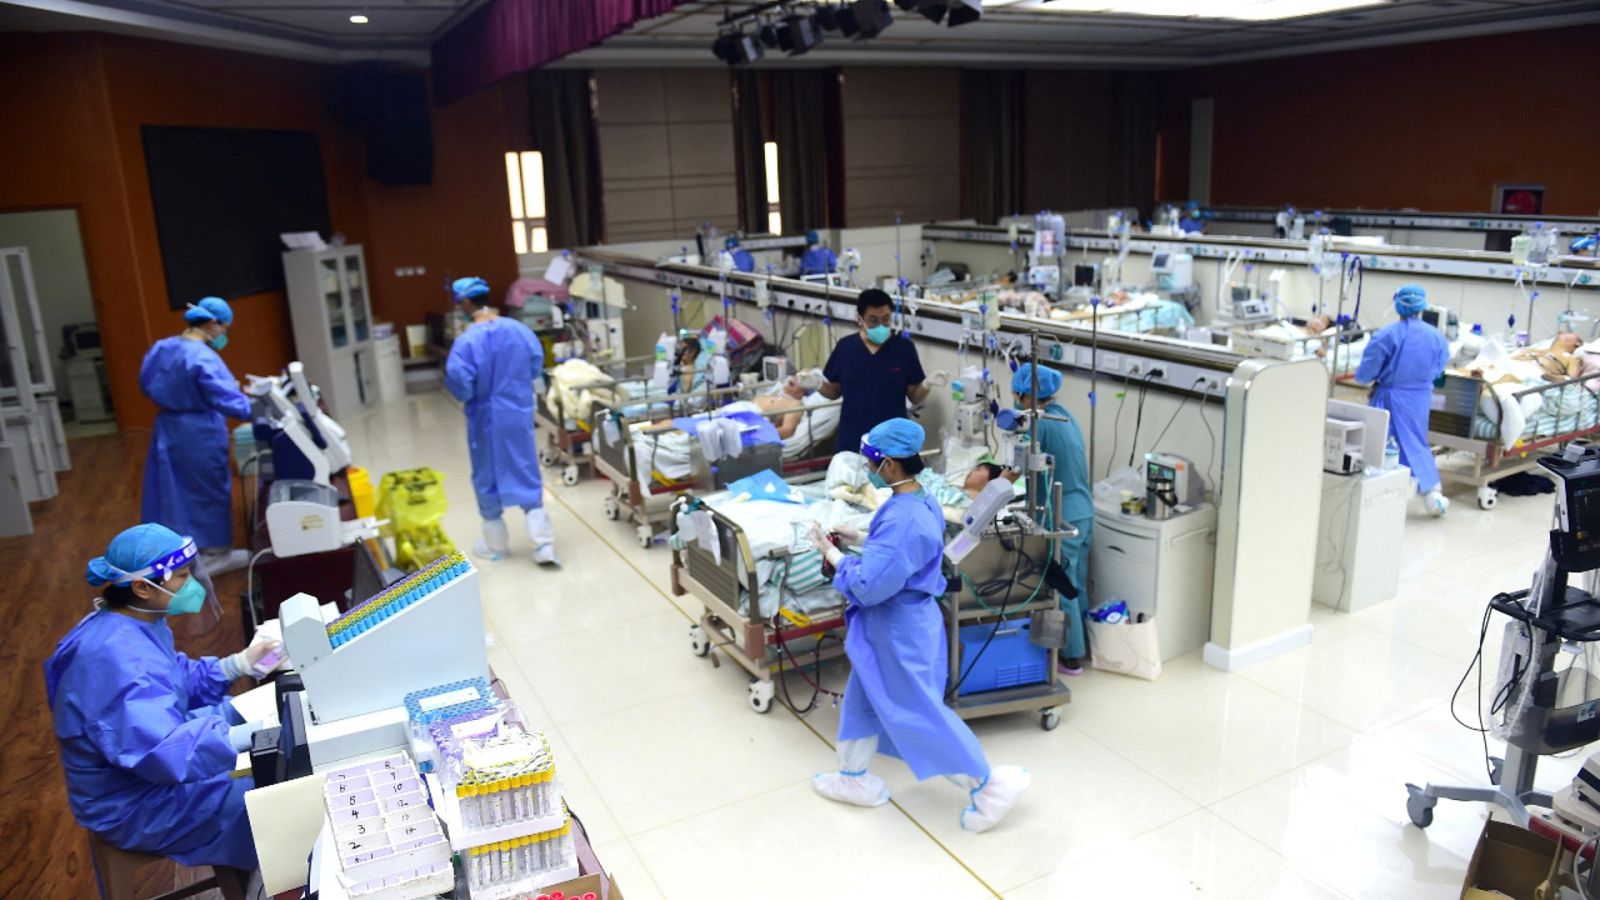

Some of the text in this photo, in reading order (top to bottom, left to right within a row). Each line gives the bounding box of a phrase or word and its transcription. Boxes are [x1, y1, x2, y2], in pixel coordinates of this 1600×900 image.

[393, 783, 403, 793] 10
[351, 809, 359, 819] 4
[356, 824, 366, 835] 3
[347, 841, 363, 850] 2
